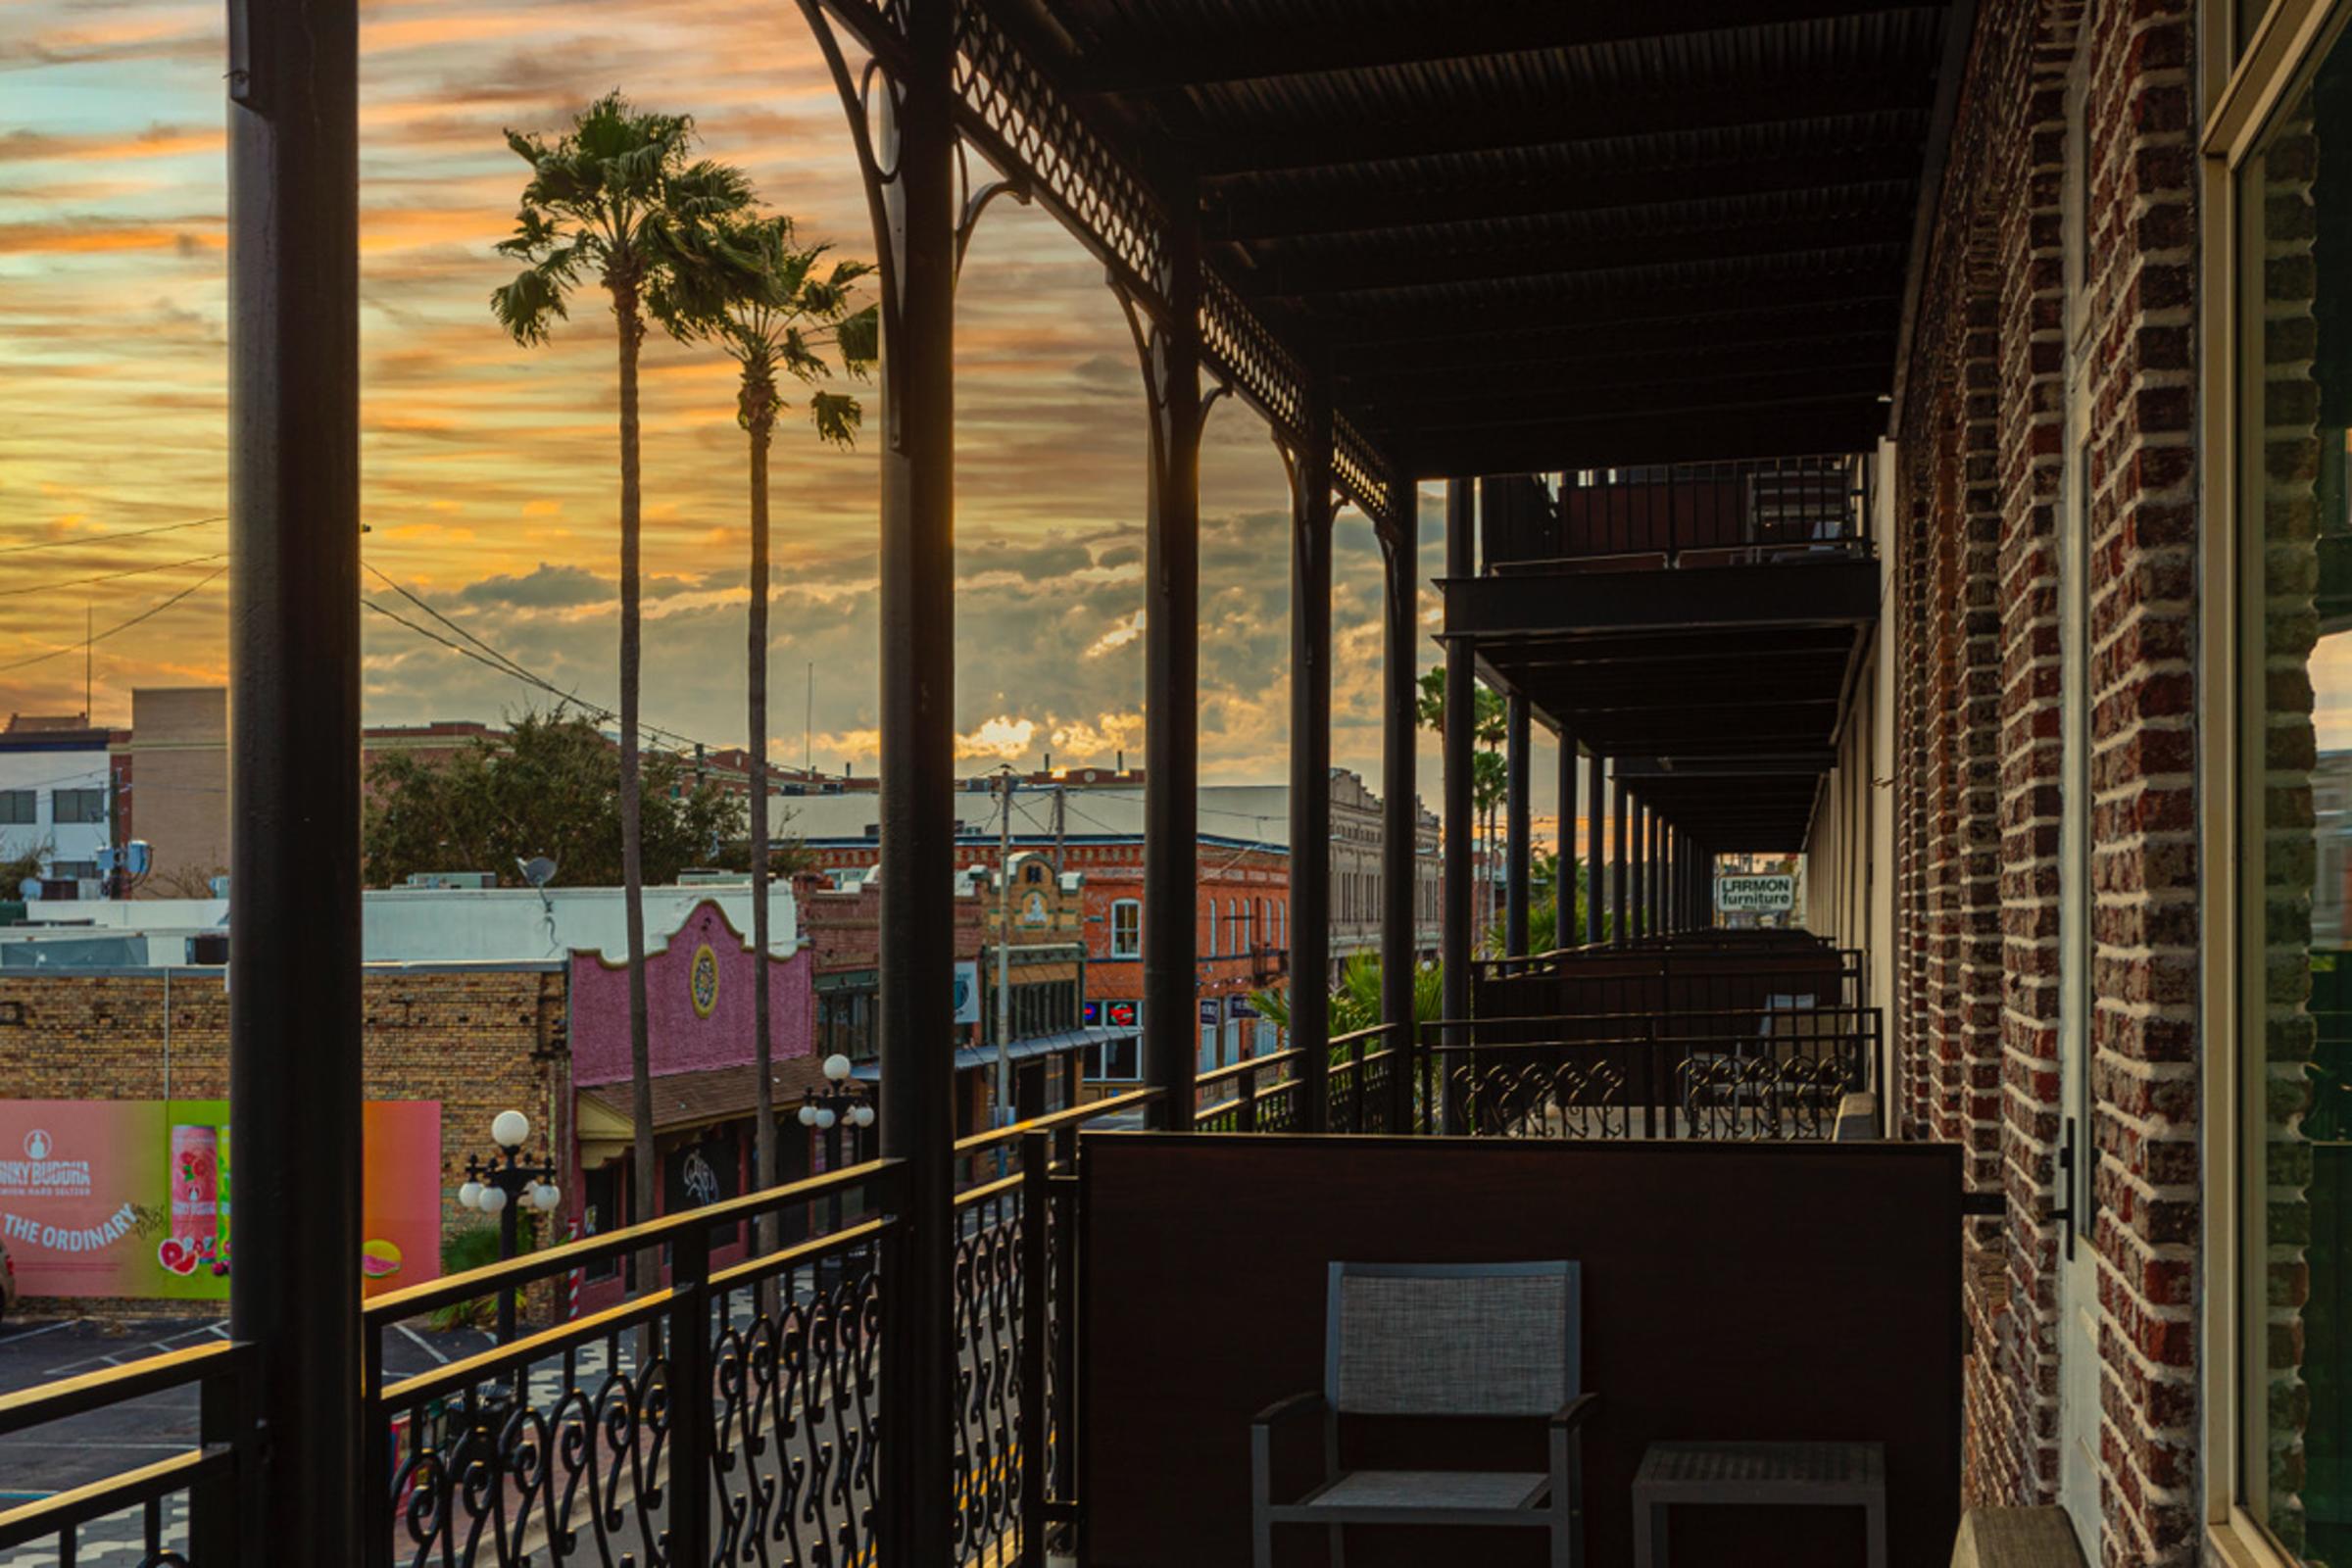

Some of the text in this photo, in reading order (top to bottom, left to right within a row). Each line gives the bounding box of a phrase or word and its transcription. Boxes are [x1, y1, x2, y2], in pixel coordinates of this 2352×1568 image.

[1722, 880, 1789, 893] LARMON
[1724, 893, 1789, 905] furniture
[32, 1161, 90, 1185] BUDDHA
[54, 1187, 91, 1197] SELTZER
[4, 1213, 41, 1245] THE
[42, 1201, 138, 1252] ORDINARY
